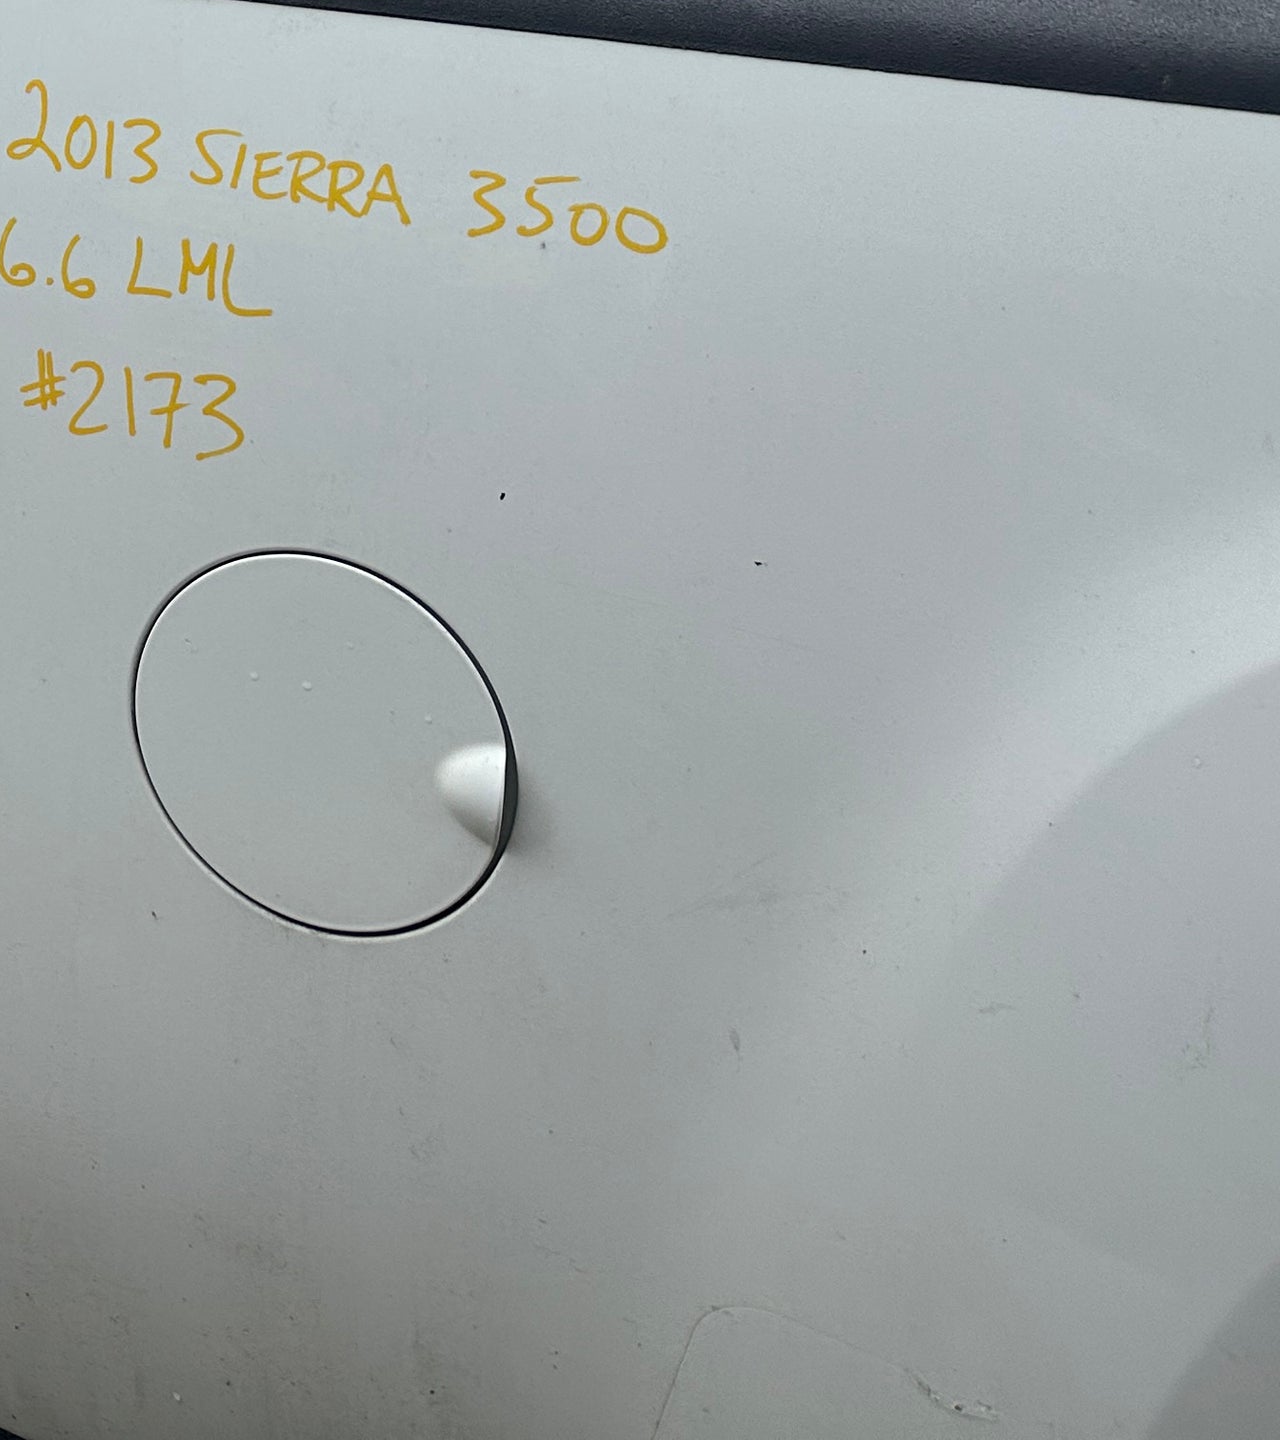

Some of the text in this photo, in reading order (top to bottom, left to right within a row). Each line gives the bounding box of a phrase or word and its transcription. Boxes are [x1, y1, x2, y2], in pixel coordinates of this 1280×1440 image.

[7, 79, 669, 255] 2013 SIERRA 3500
[127, 237, 273, 317] LML
[20, 349, 245, 461] #2173
